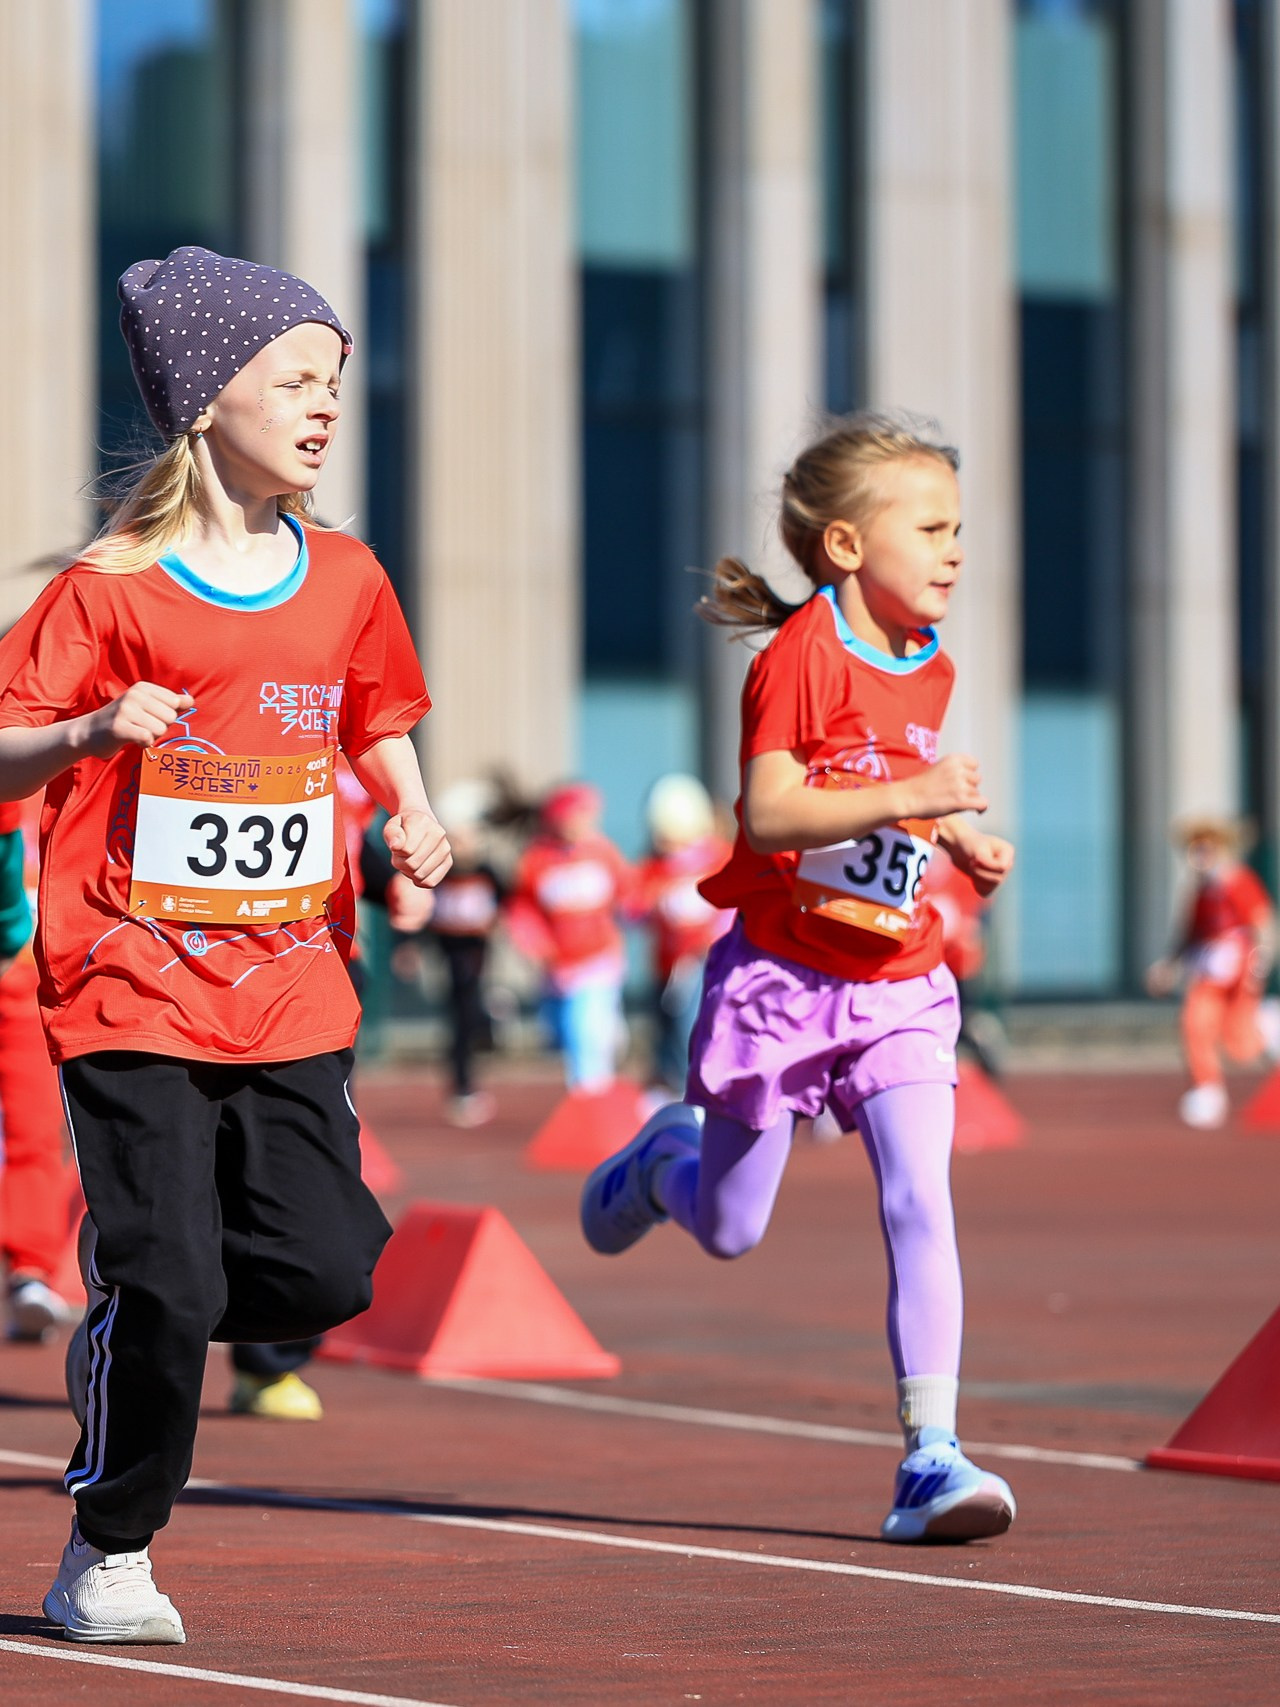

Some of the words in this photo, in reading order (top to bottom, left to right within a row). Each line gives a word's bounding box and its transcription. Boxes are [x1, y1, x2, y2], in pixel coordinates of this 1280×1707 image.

[159, 753, 261, 778] ДЕТСКИЙ
[265, 765, 302, 775] 2026
[174, 774, 246, 794] ЗАБЕГ
[304, 772, 328, 796] 6-7
[187, 813, 308, 878] 339
